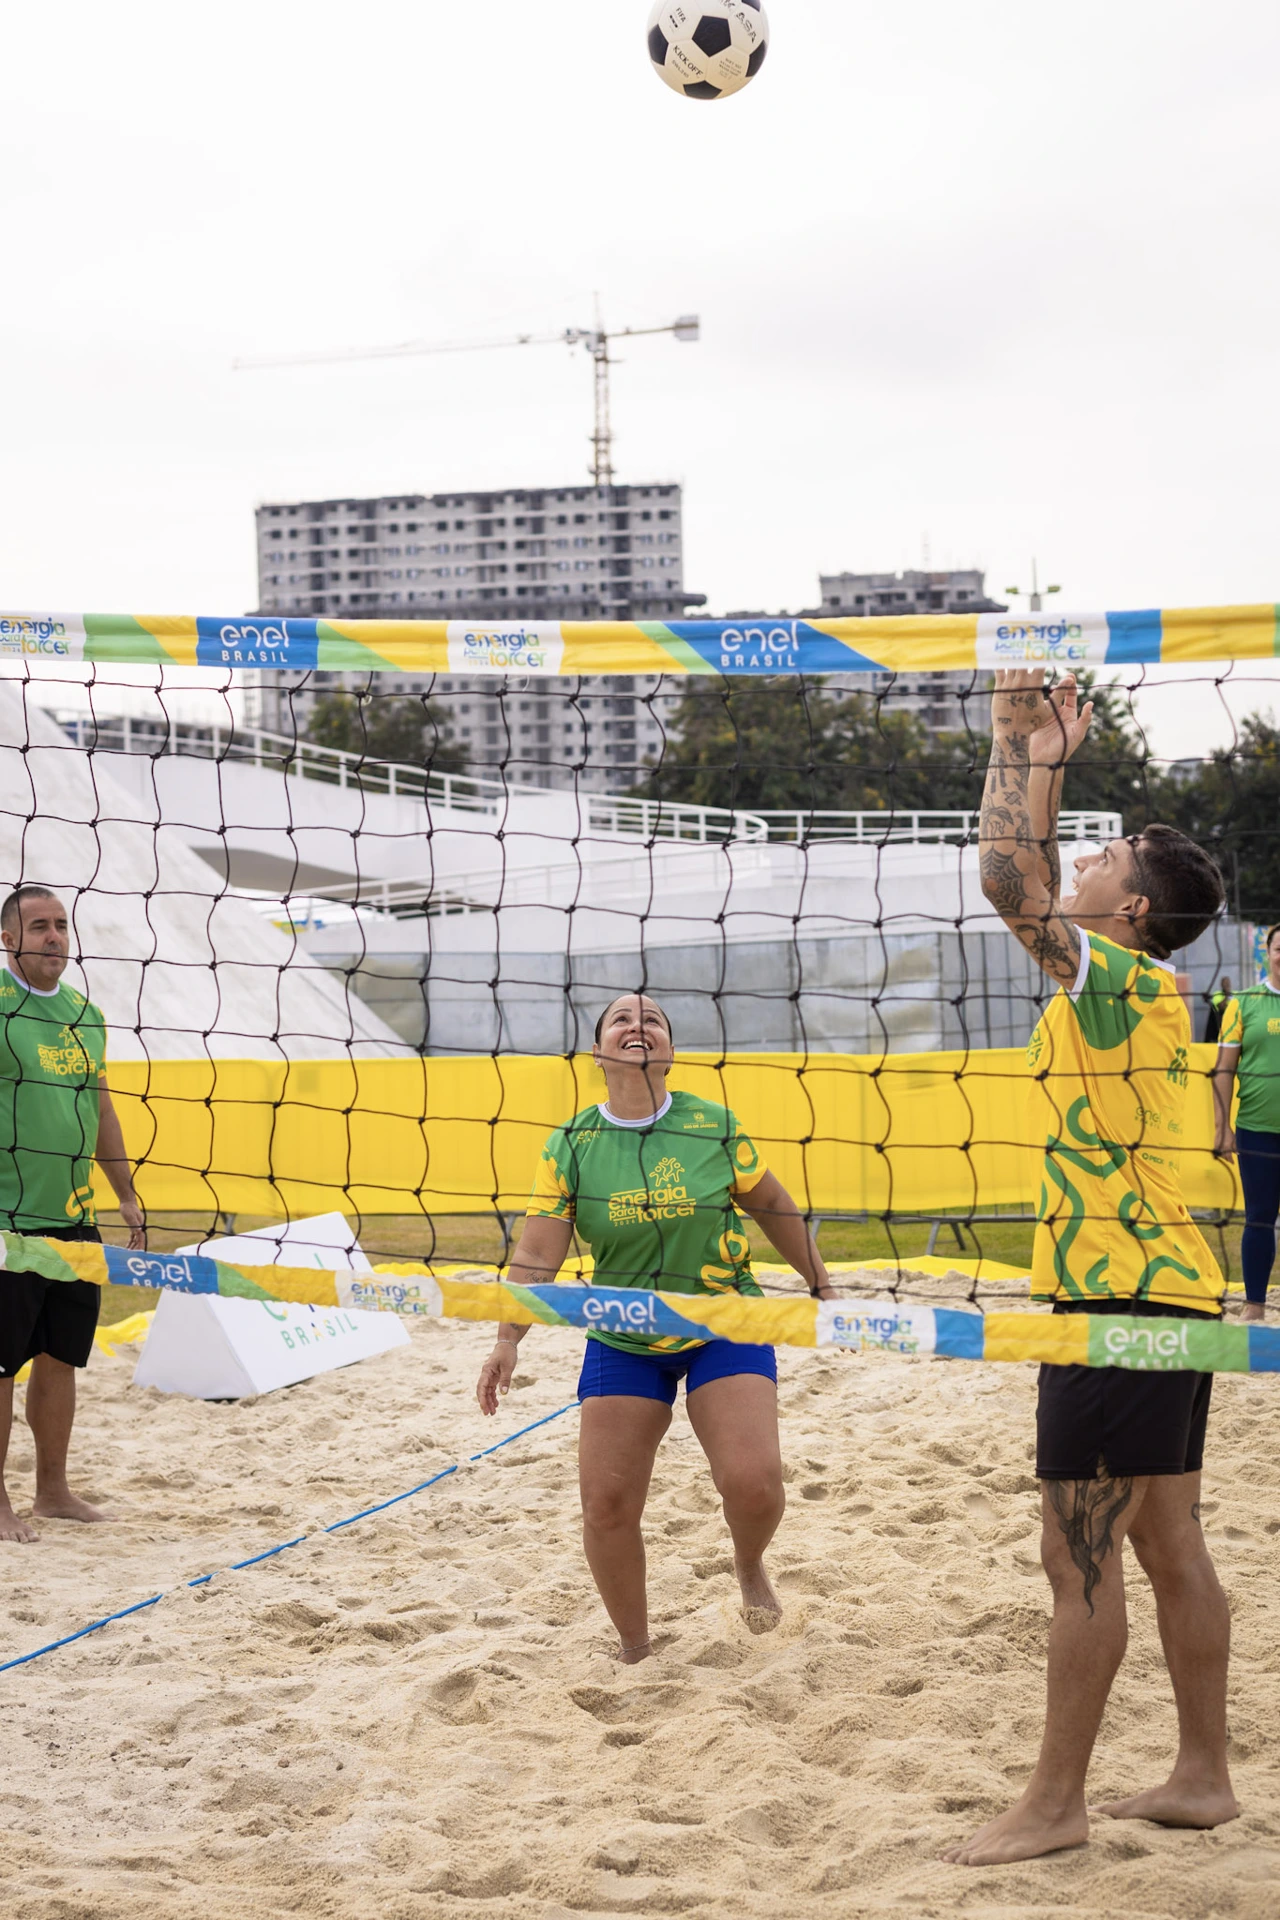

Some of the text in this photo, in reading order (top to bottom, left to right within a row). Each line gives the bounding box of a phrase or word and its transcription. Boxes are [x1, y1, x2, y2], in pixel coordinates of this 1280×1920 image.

[676, 7, 687, 23] FIFA
[673, 45, 690, 65] KICK
[687, 62, 704, 76] OFF
[0, 617, 66, 639] energia
[220, 620, 290, 648] enel
[464, 628, 539, 651] energia
[721, 621, 799, 652] enel
[996, 619, 1082, 644] energia
[21, 634, 72, 655] torcer
[221, 650, 288, 662] BRASIL
[1025, 641, 1090, 660] torcer
[489, 648, 547, 667] torcer
[721, 654, 796, 667] BRASIL
[608, 1183, 687, 1210] energia
[609, 1201, 697, 1223] para torcer
[127, 1257, 193, 1283] enel
[351, 1283, 420, 1302] energia
[583, 1295, 657, 1325] enel
[281, 1313, 358, 1349] BRASIL
[833, 1314, 911, 1338] energia
[1104, 1323, 1190, 1357] enel
